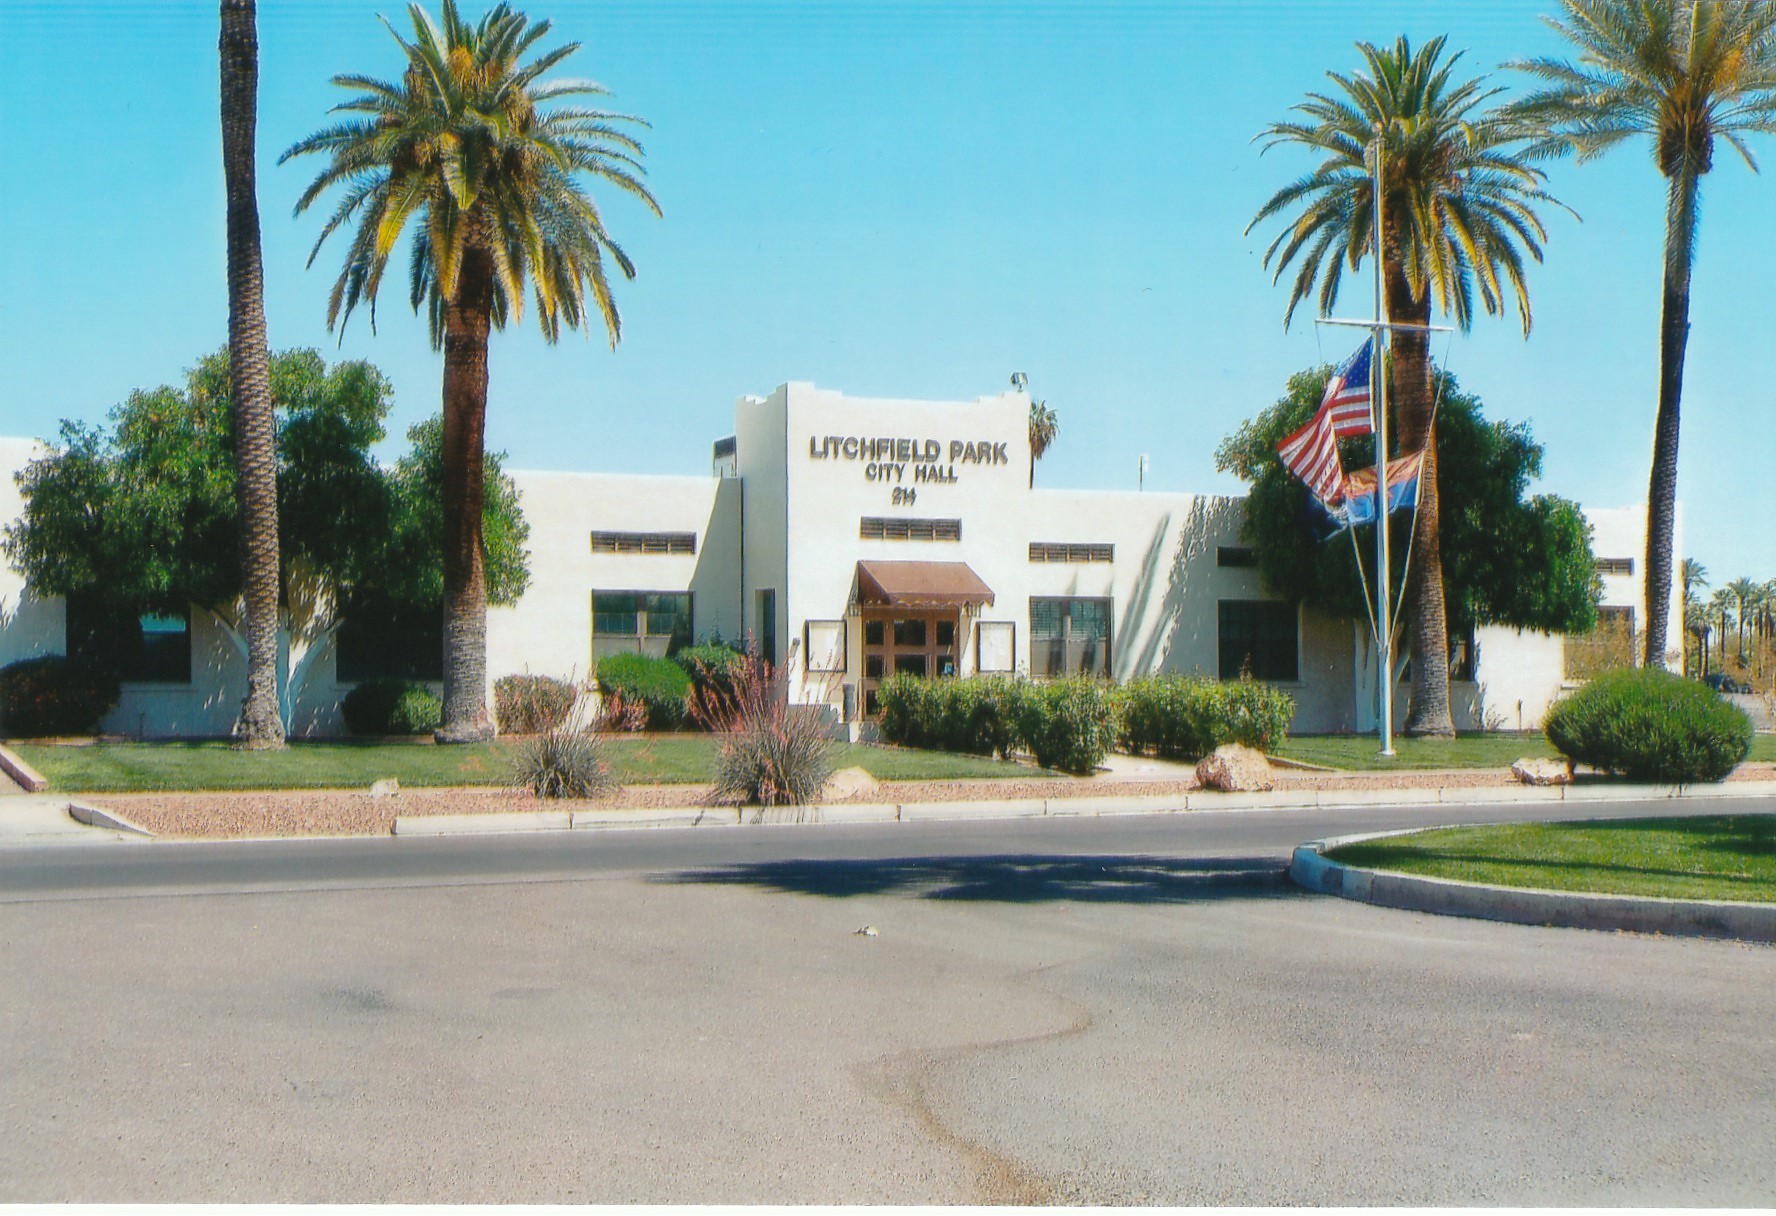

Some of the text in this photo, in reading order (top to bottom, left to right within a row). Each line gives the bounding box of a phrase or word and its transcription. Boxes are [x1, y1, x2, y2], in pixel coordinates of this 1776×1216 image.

[810, 435, 1008, 464] LITCHFIELD PARK
[865, 463, 958, 483] CITY HALL
[891, 486, 917, 506] 214
